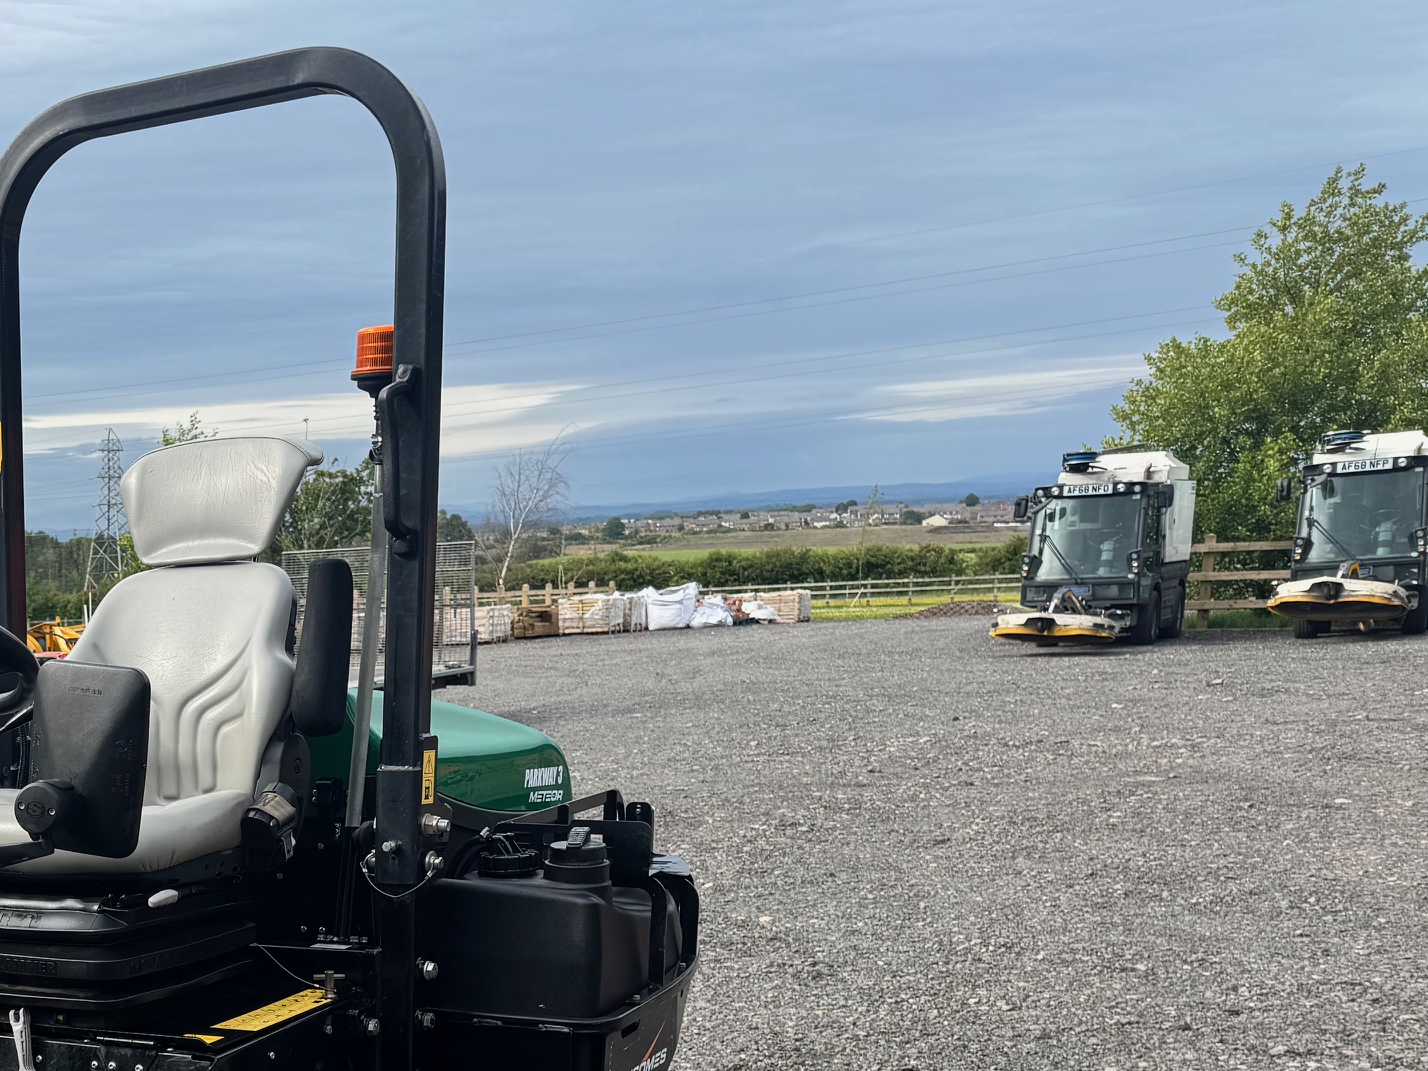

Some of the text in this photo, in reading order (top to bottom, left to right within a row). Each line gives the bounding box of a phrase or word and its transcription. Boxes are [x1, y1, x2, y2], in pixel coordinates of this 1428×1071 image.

[1341, 459, 1389, 471] AF68 NFP
[1067, 484, 1109, 494] AF68 NFO
[524, 765, 563, 788] PARKWAY 3
[528, 790, 564, 803] METEOR
